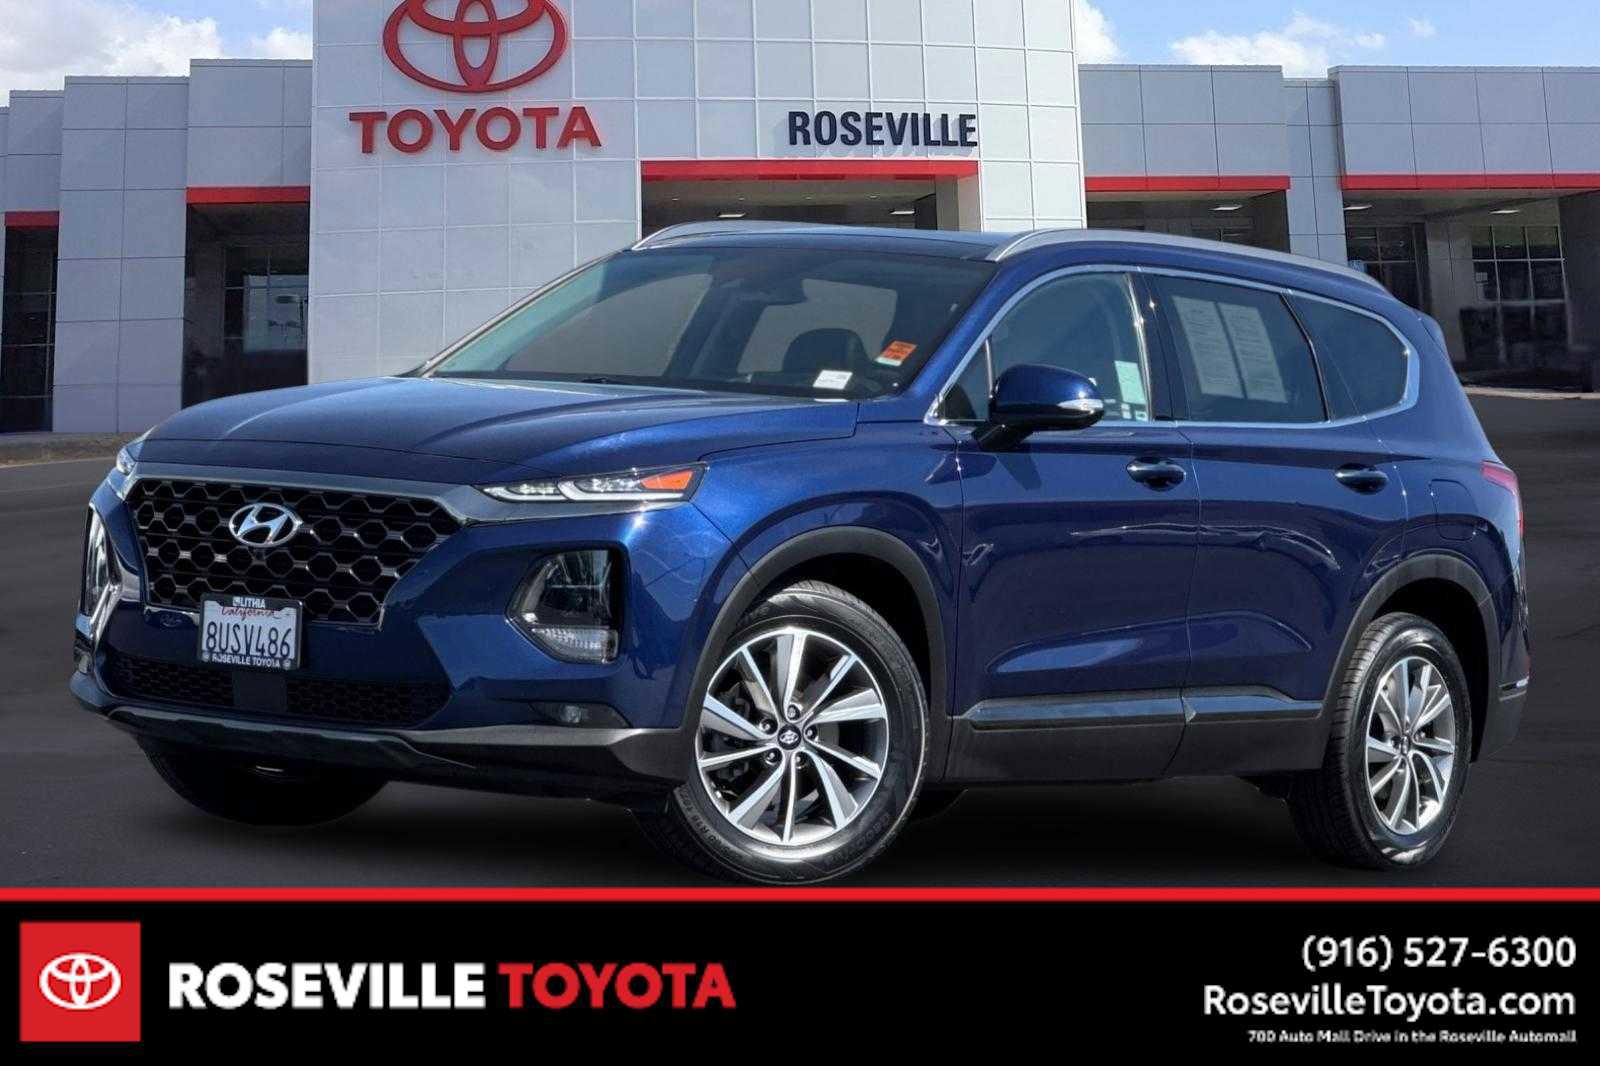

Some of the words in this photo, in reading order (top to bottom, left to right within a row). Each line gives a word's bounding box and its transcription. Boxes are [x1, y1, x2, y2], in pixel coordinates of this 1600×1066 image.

[349, 106, 602, 153] TOYOTA
[788, 111, 979, 148] ROSEVILLE
[240, 597, 266, 609] LITHIA
[205, 621, 293, 659] 8USV486
[212, 653, 251, 666] ROSEVILLE
[252, 656, 281, 669] TOYOTA
